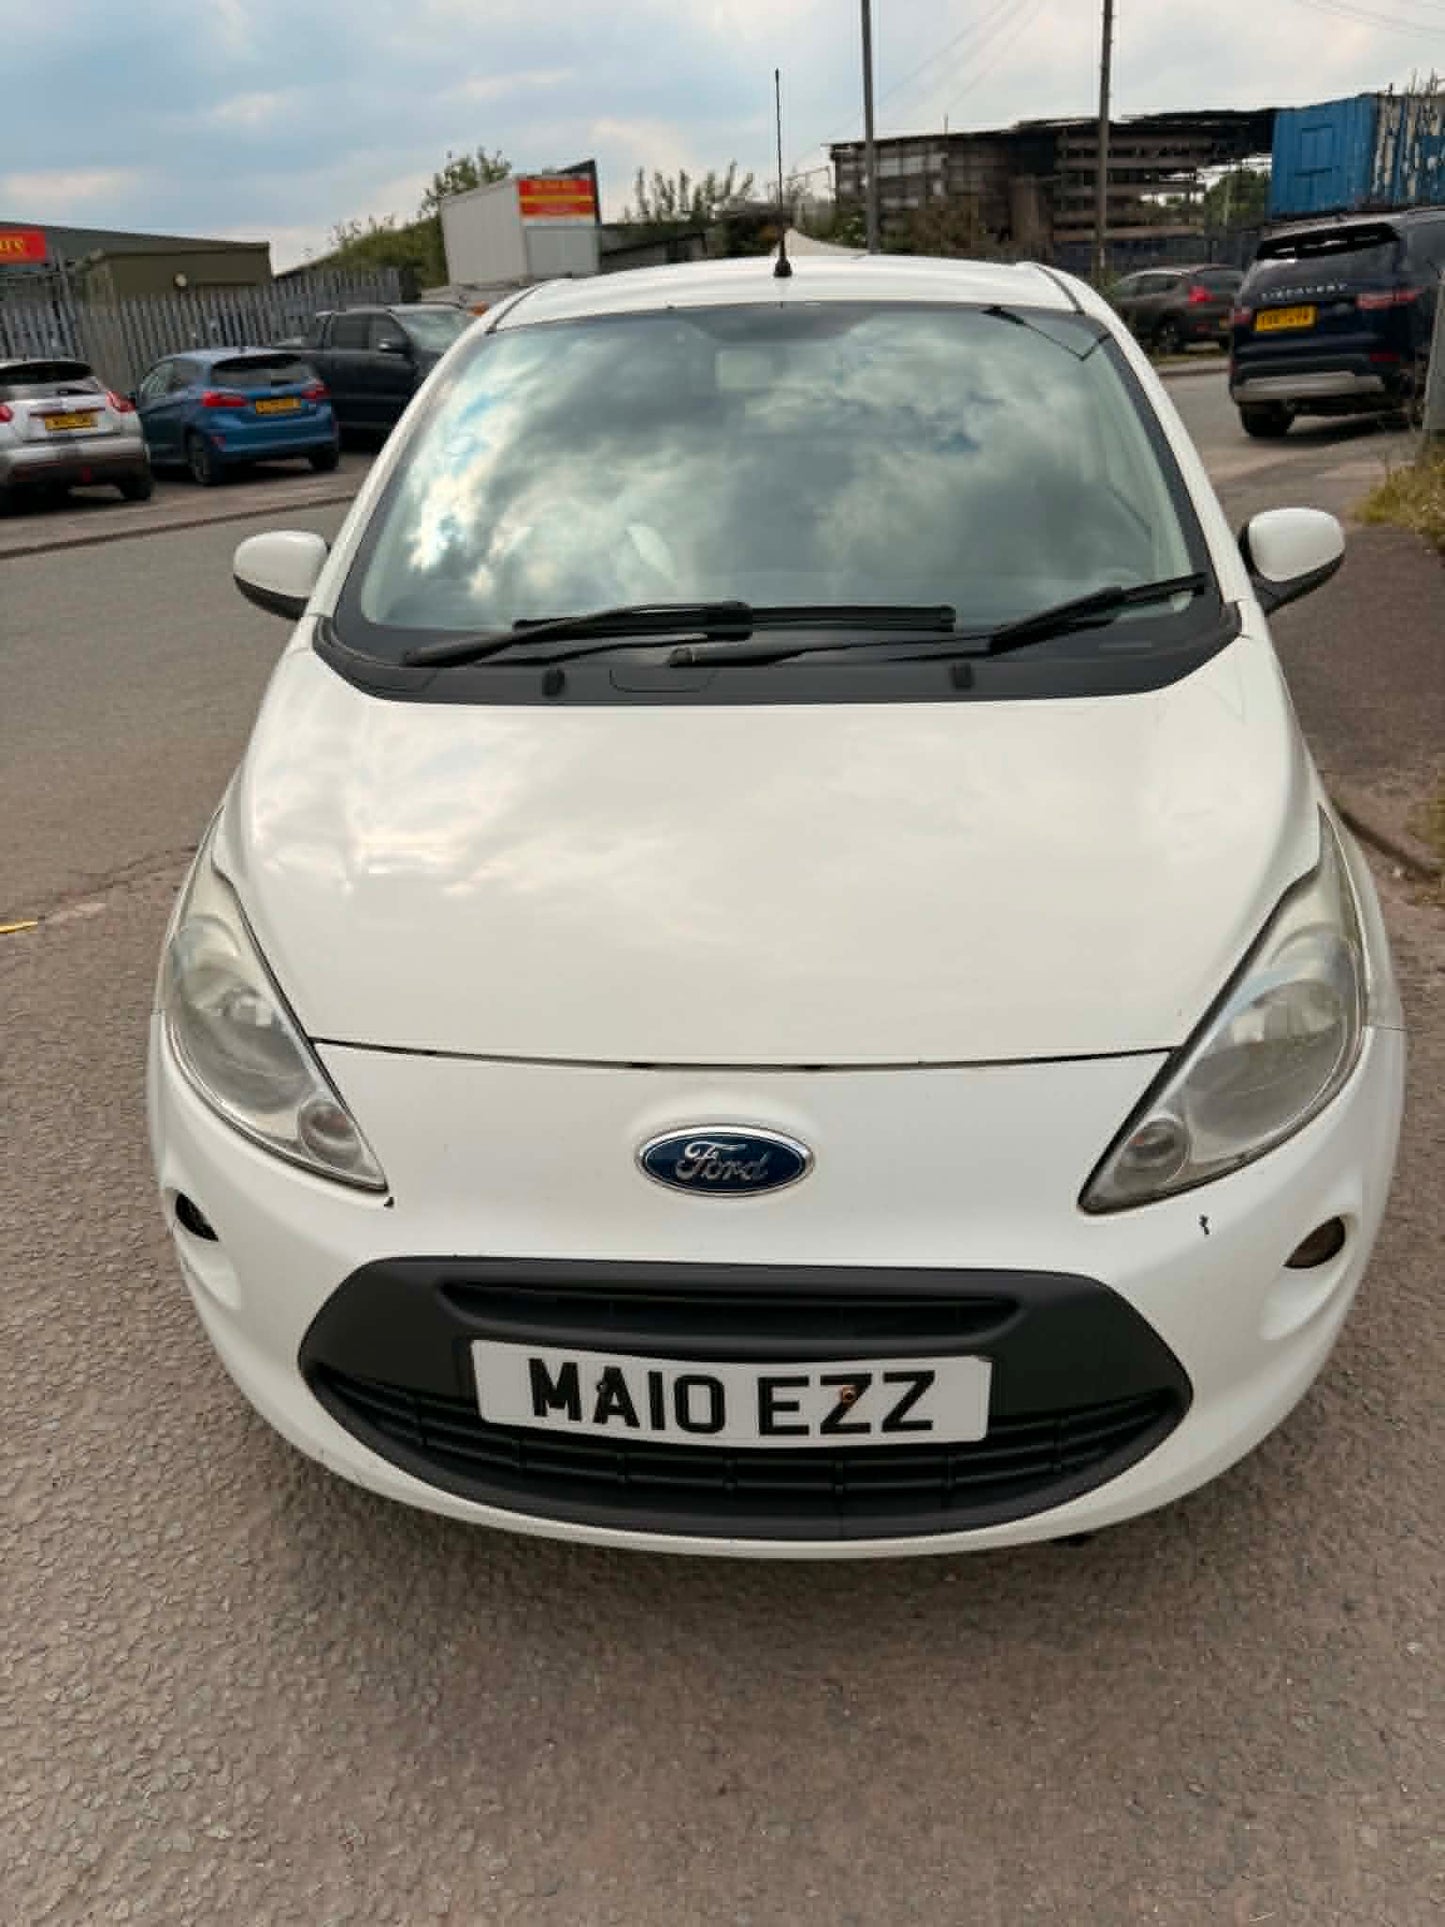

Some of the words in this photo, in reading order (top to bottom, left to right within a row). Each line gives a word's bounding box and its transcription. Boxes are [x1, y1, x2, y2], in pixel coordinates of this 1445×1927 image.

[675, 1140, 768, 1181] Ford
[528, 1358, 725, 1434] MA10
[757, 1370, 935, 1435] EZZ
